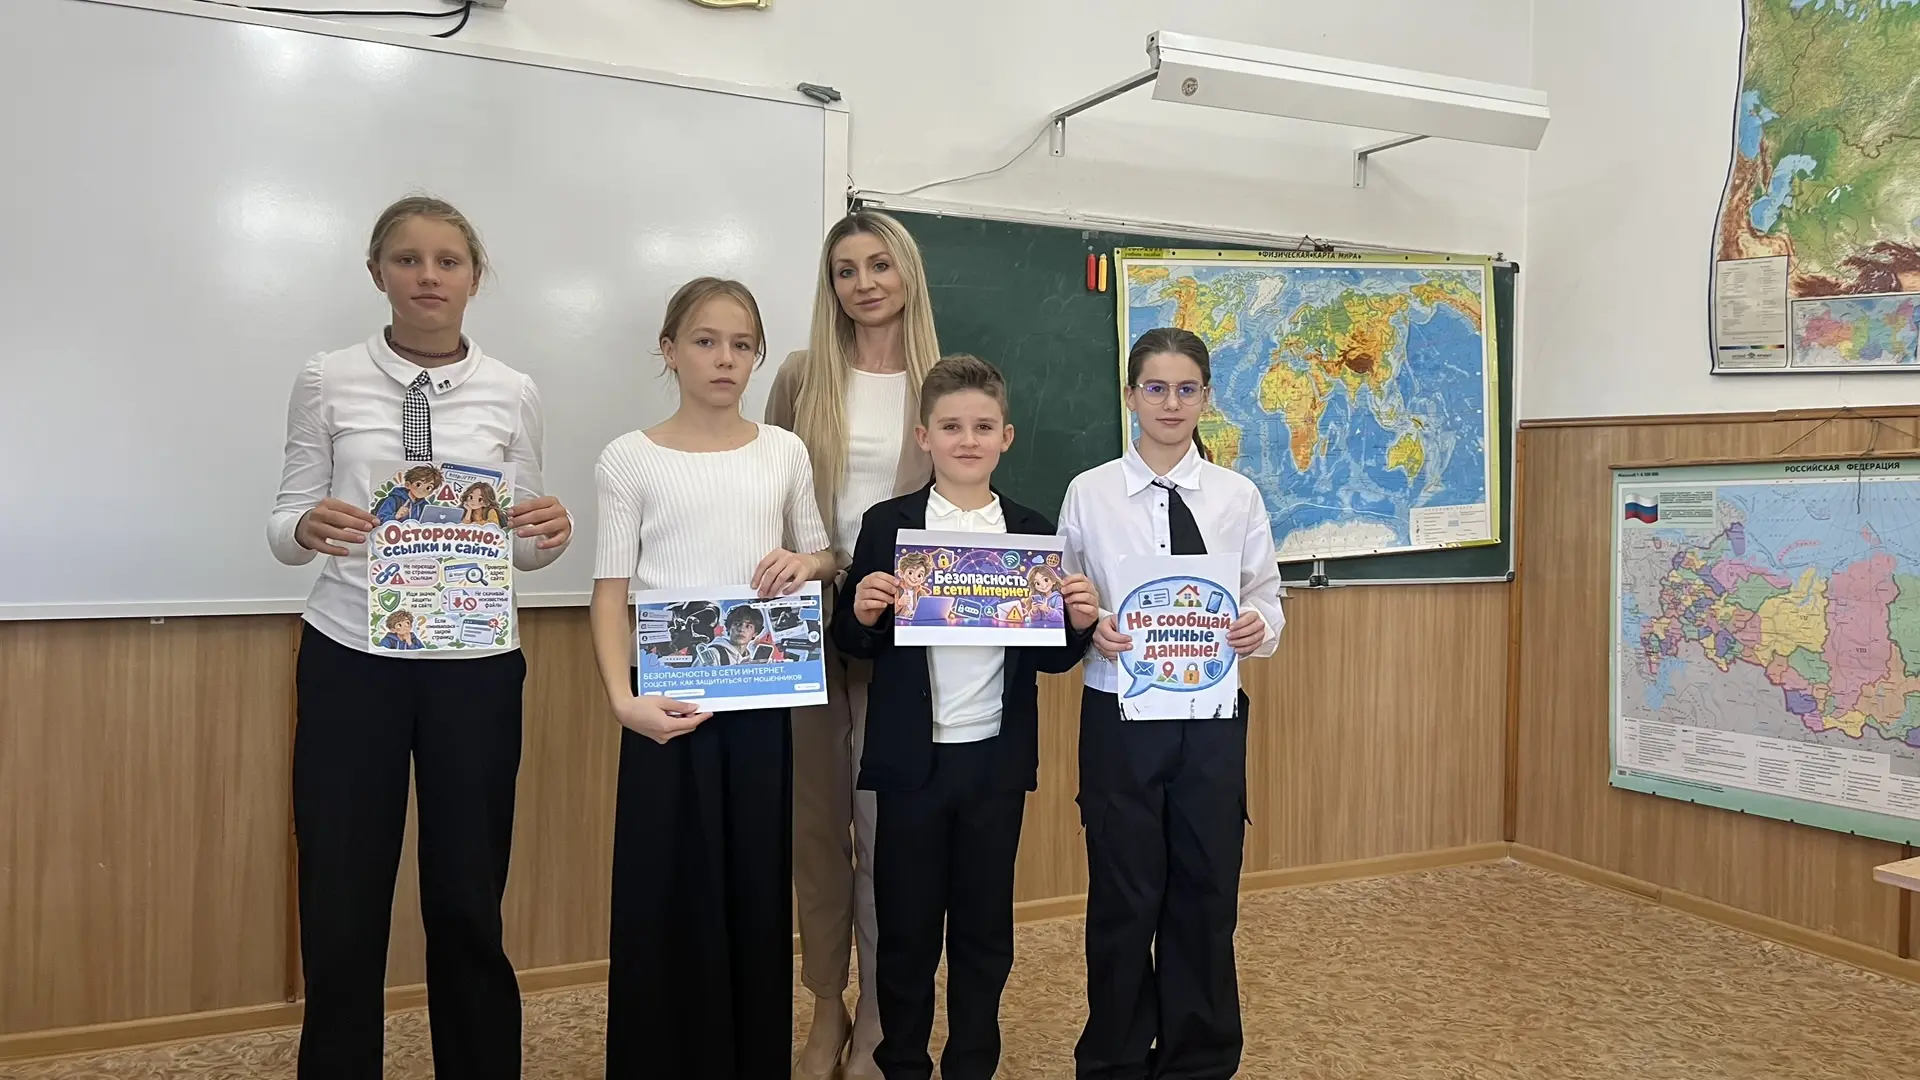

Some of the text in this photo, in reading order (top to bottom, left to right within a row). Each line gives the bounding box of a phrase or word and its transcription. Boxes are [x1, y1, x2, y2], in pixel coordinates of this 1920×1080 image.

[1785, 462, 1900, 472] РОССИЙСКАЯ ФЕДЕРАЦИЯ
[383, 542, 499, 558] ссылки и сайты
[934, 570, 1028, 586] Безопасность
[932, 584, 1030, 598] в сети Интернет
[1126, 612, 1231, 630] Не сообщай
[1145, 629, 1214, 643] личные
[1143, 642, 1220, 660] данные!
[643, 670, 710, 679] БЕЗОПАСНОСТЬ
[718, 668, 740, 676] СЕТИ
[696, 678, 742, 686] ЗАЩИТИТЬСЯ
[754, 674, 802, 682] МОШЕННИКОВ
